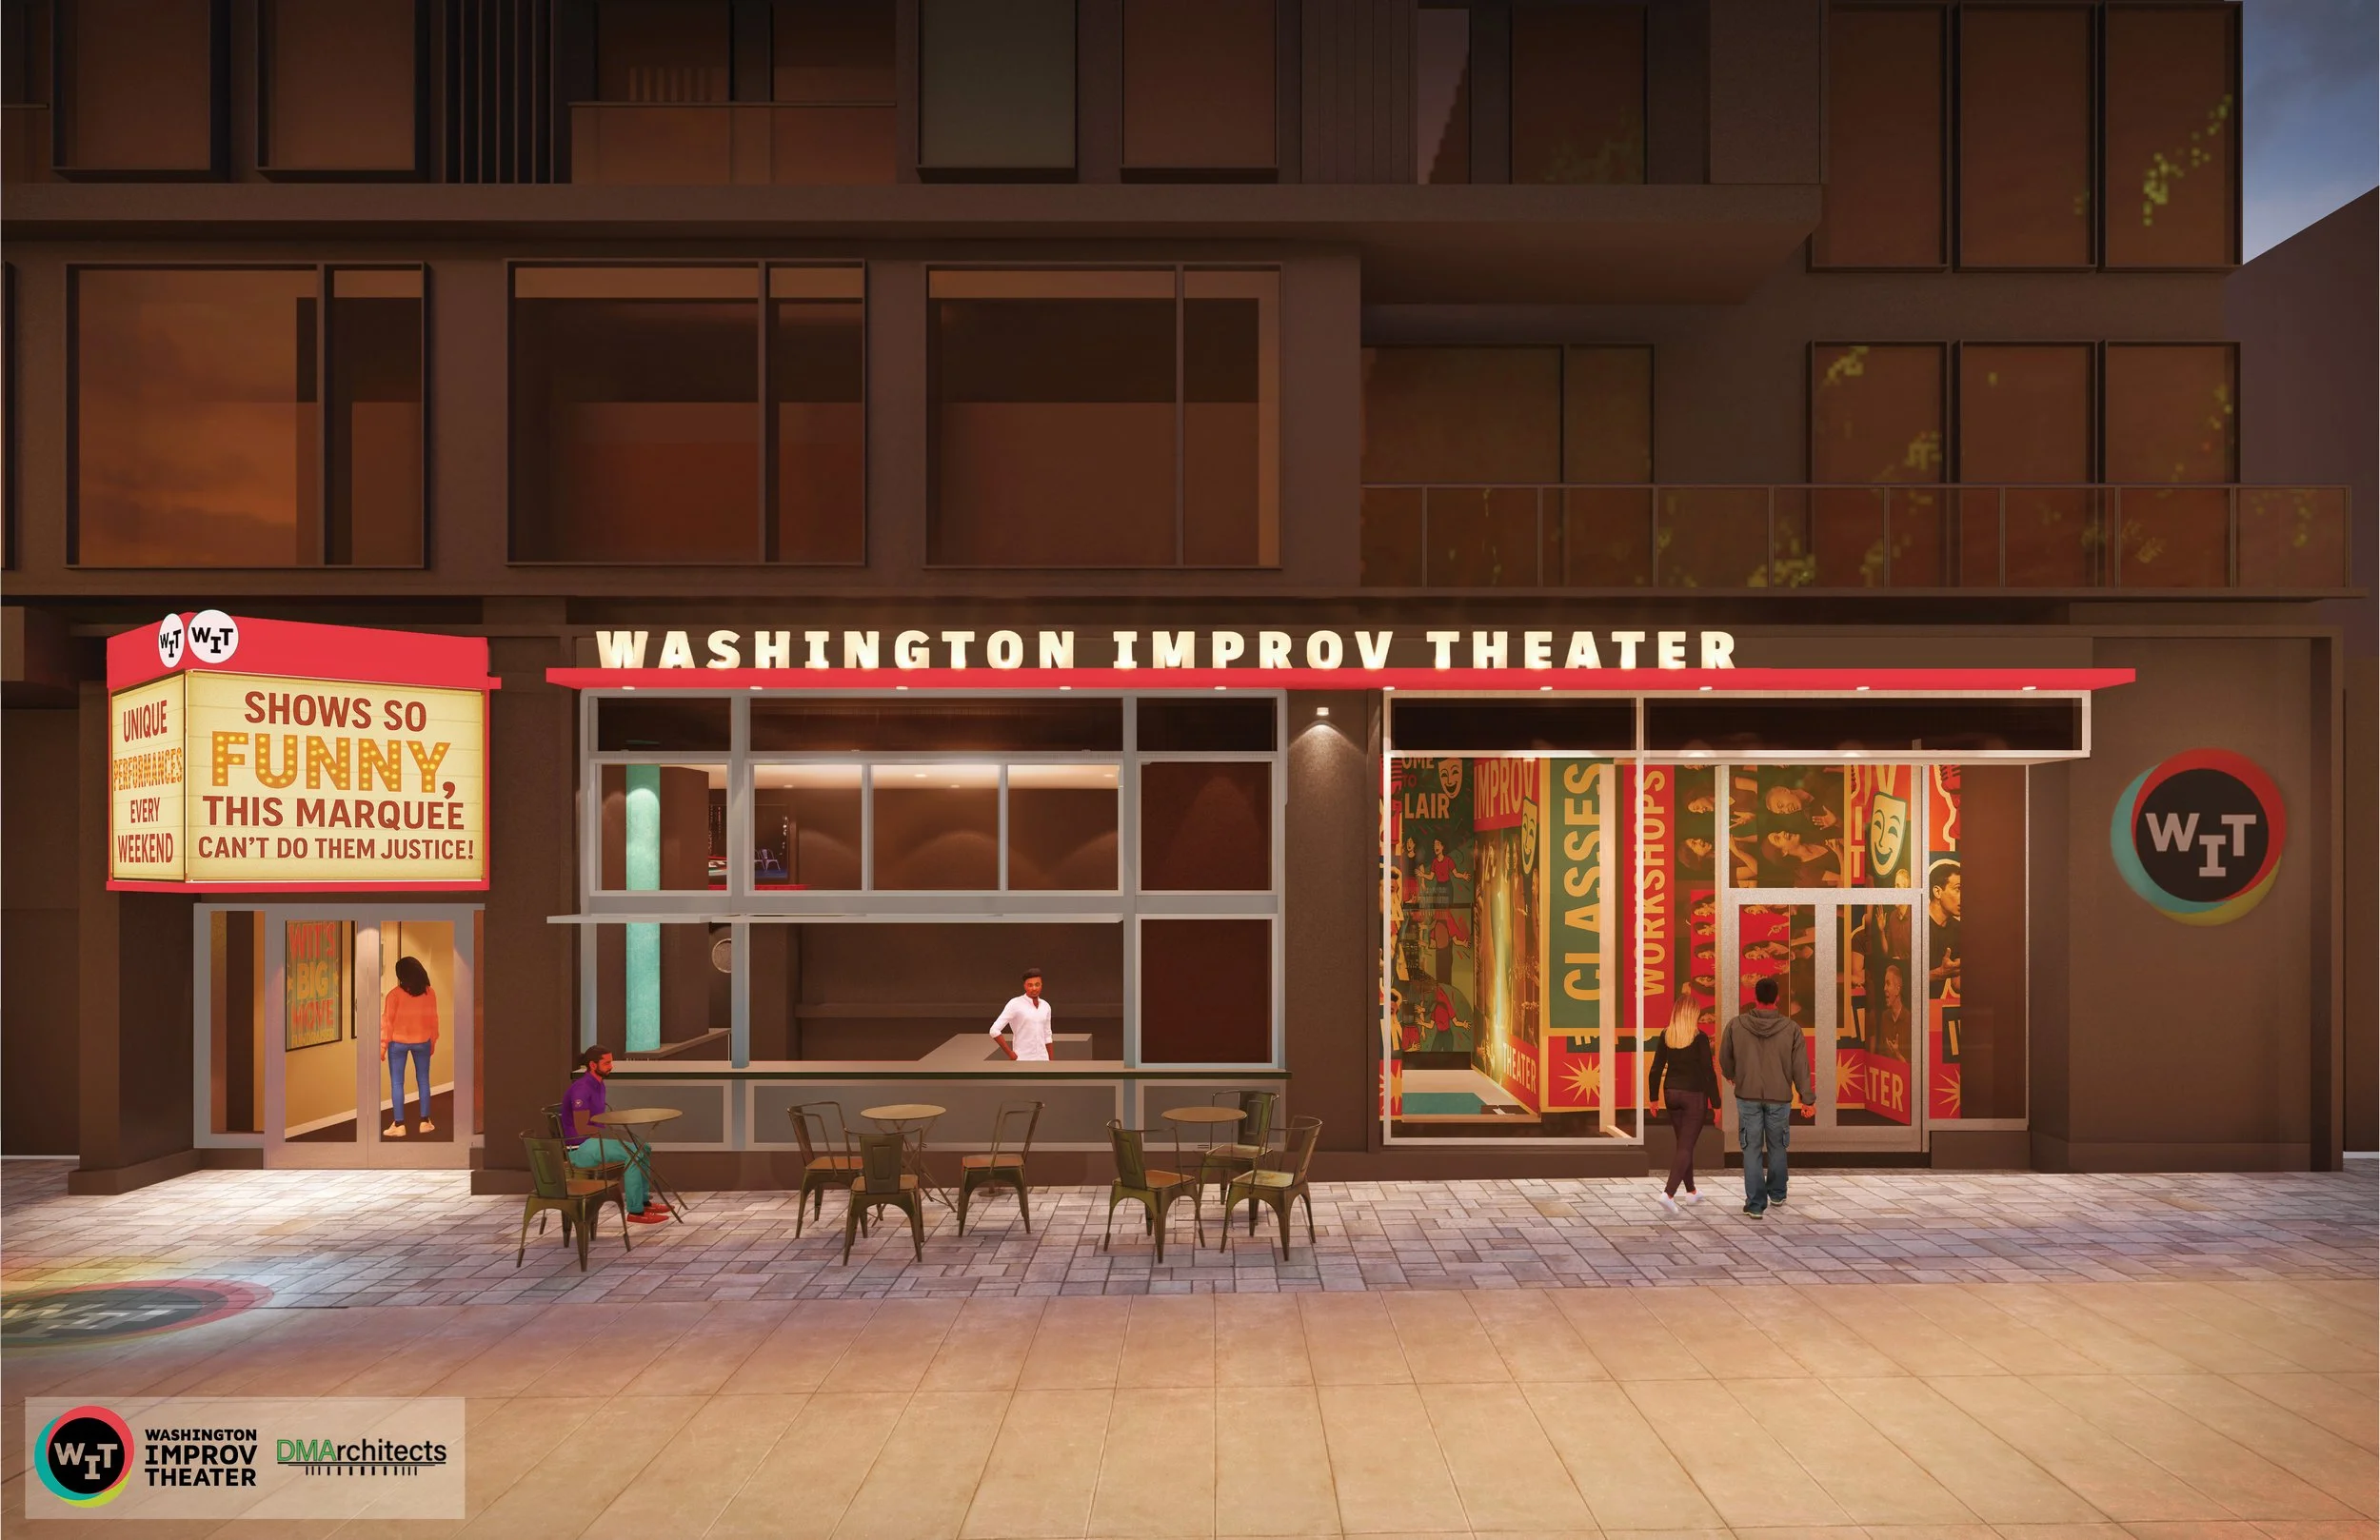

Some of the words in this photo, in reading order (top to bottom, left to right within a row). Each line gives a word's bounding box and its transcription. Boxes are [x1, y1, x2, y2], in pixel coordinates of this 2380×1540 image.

[160, 629, 182, 658] WIT
[191, 627, 233, 654] WIT
[596, 630, 1074, 669] WASHINGTON
[1113, 630, 1393, 669] IMPROV
[1426, 630, 1735, 669] THEATER
[123, 700, 168, 742] UNIQUE
[244, 691, 372, 729] SHOWS
[383, 700, 427, 732] SO
[113, 747, 183, 792] PERFORMANCES
[211, 731, 456, 800] FUNNY,
[1473, 757, 1536, 820] IMPROV
[130, 797, 161, 824] EVERY
[202, 796, 284, 827] THIS
[296, 798, 465, 831] MARQUEE
[117, 833, 174, 863] WEEKEND
[198, 836, 269, 859] CAN'T
[277, 837, 308, 859] DO
[314, 838, 375, 859] THEM
[381, 839, 474, 860] JUSTICE!
[2145, 813, 2257, 878] WIT
[1563, 762, 1600, 1001] CLASSES
[1634, 770, 1666, 998] WORKSHOPS
[296, 960, 329, 1000] BIG
[290, 997, 335, 1033] MOVE
[1502, 1042, 1537, 1095] THEATER
